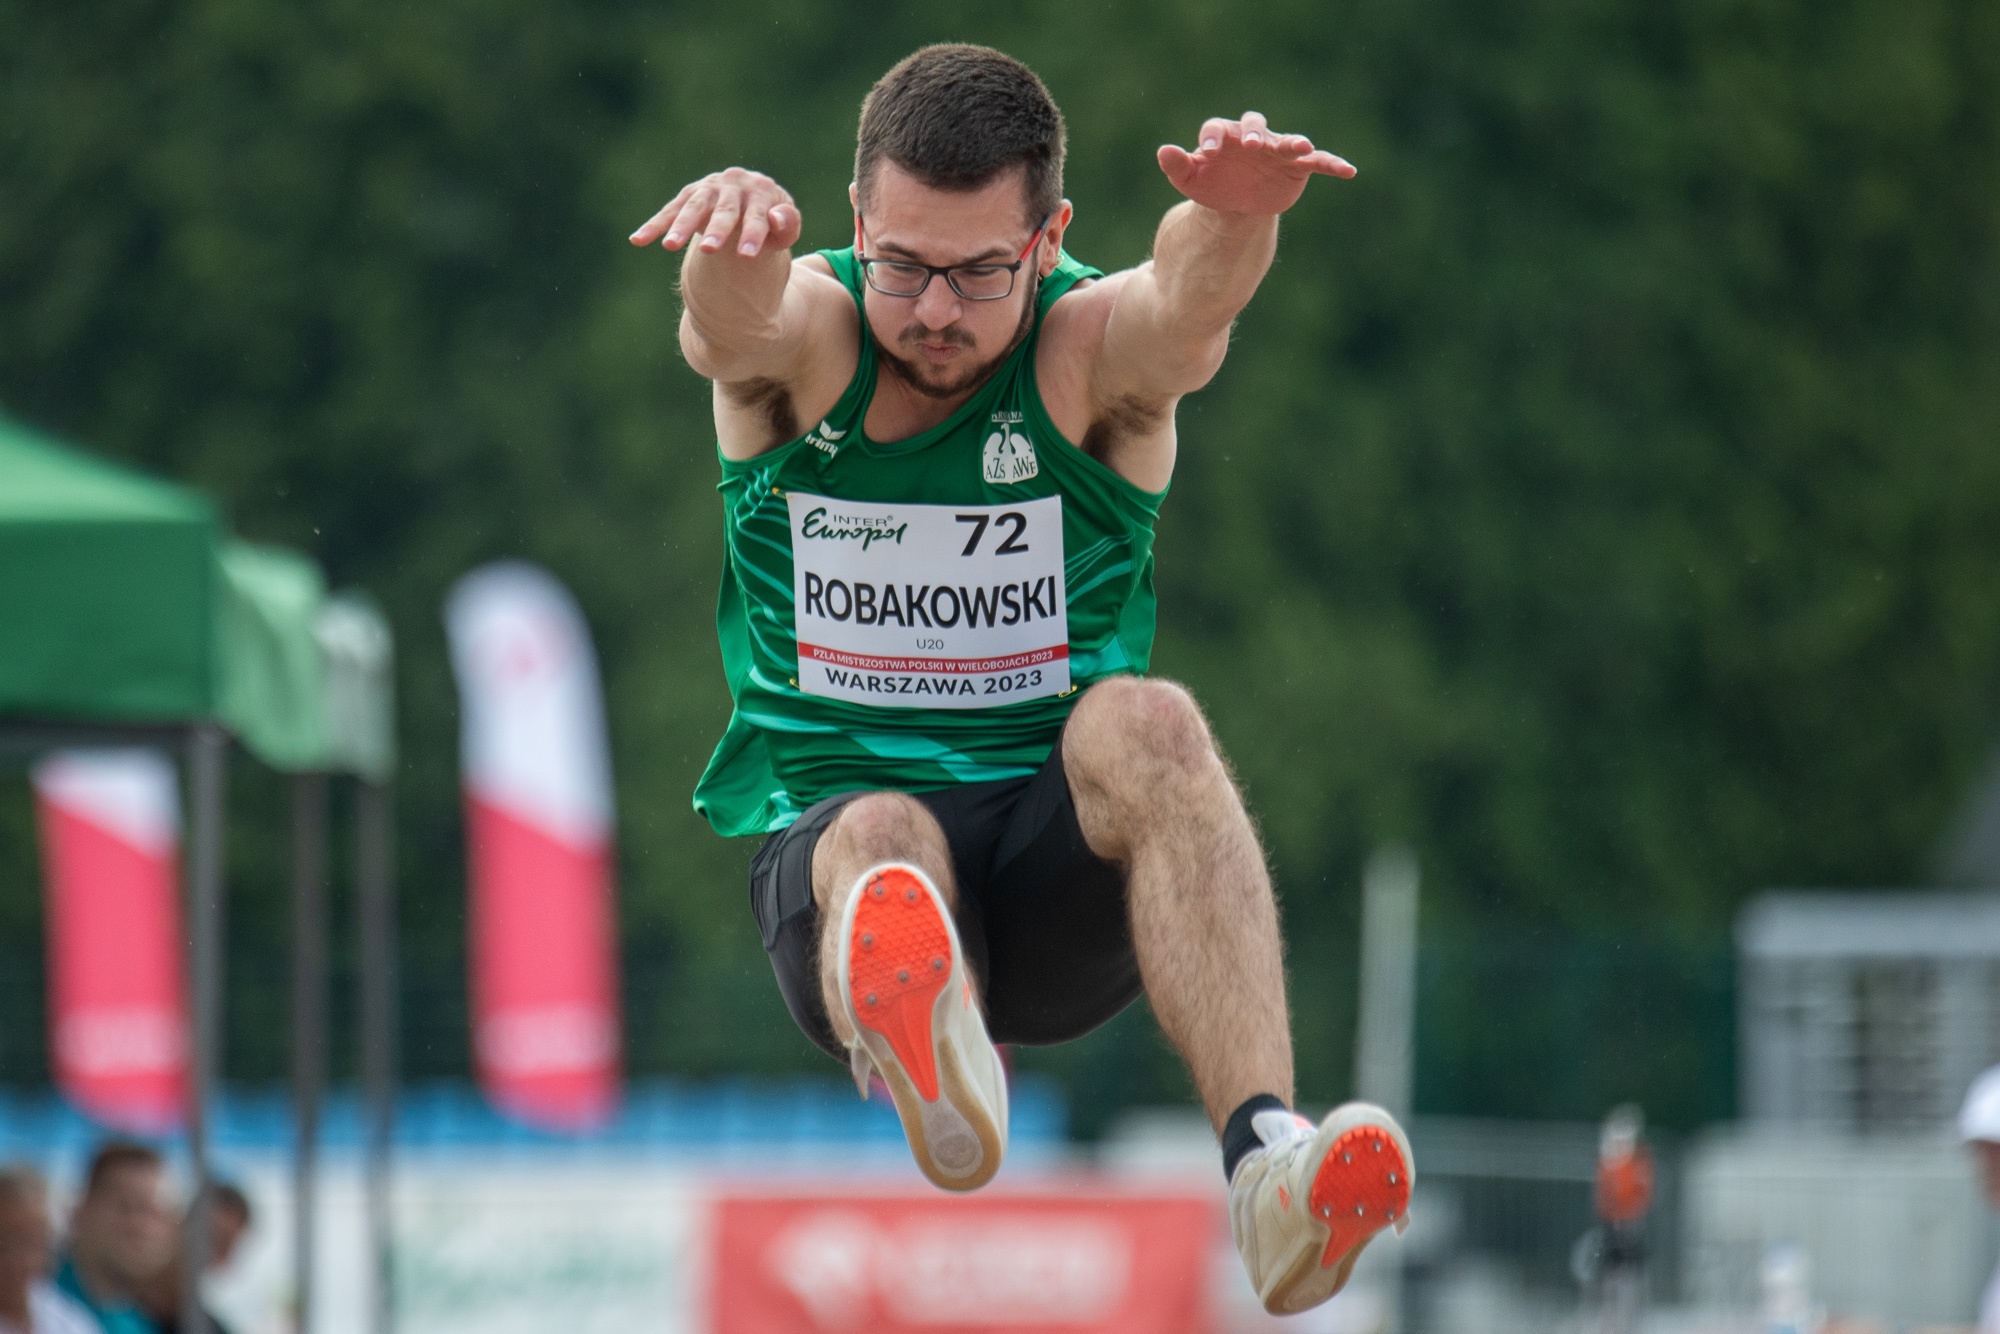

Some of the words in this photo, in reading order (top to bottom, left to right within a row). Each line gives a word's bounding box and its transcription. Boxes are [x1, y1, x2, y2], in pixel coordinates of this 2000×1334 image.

[986, 457, 1006, 479] AZS
[1013, 456, 1036, 478] AWF
[802, 507, 908, 551] Europol
[955, 512, 1029, 557] 72
[805, 571, 1057, 629] ROBAKOWSKI
[916, 639, 944, 650] U20
[813, 648, 836, 662] PZLA
[836, 654, 907, 670] MISTRZOSTWA
[908, 661, 943, 671] POLSKI
[945, 662, 956, 671] W
[958, 656, 1029, 671] WIELOBOJACH
[1031, 650, 1053, 663] 2023
[825, 667, 976, 695] WARSZAWA
[984, 669, 1043, 695] 2023
